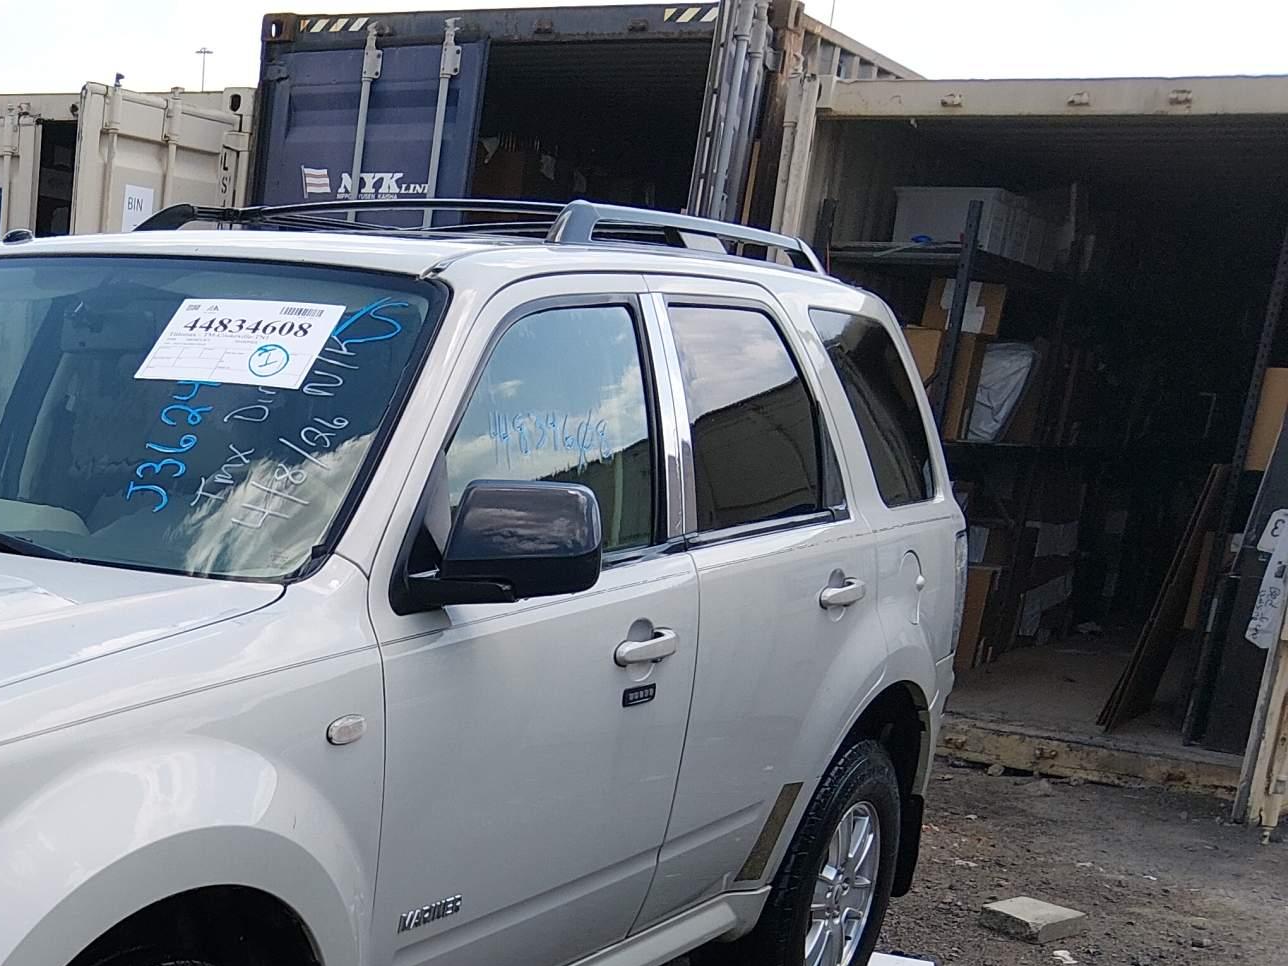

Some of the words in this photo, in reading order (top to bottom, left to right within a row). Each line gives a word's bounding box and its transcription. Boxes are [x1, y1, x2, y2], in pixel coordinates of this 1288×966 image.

[127, 196, 144, 212] BIN
[184, 316, 313, 338] 44834608
[397, 894, 462, 934] MARINER
